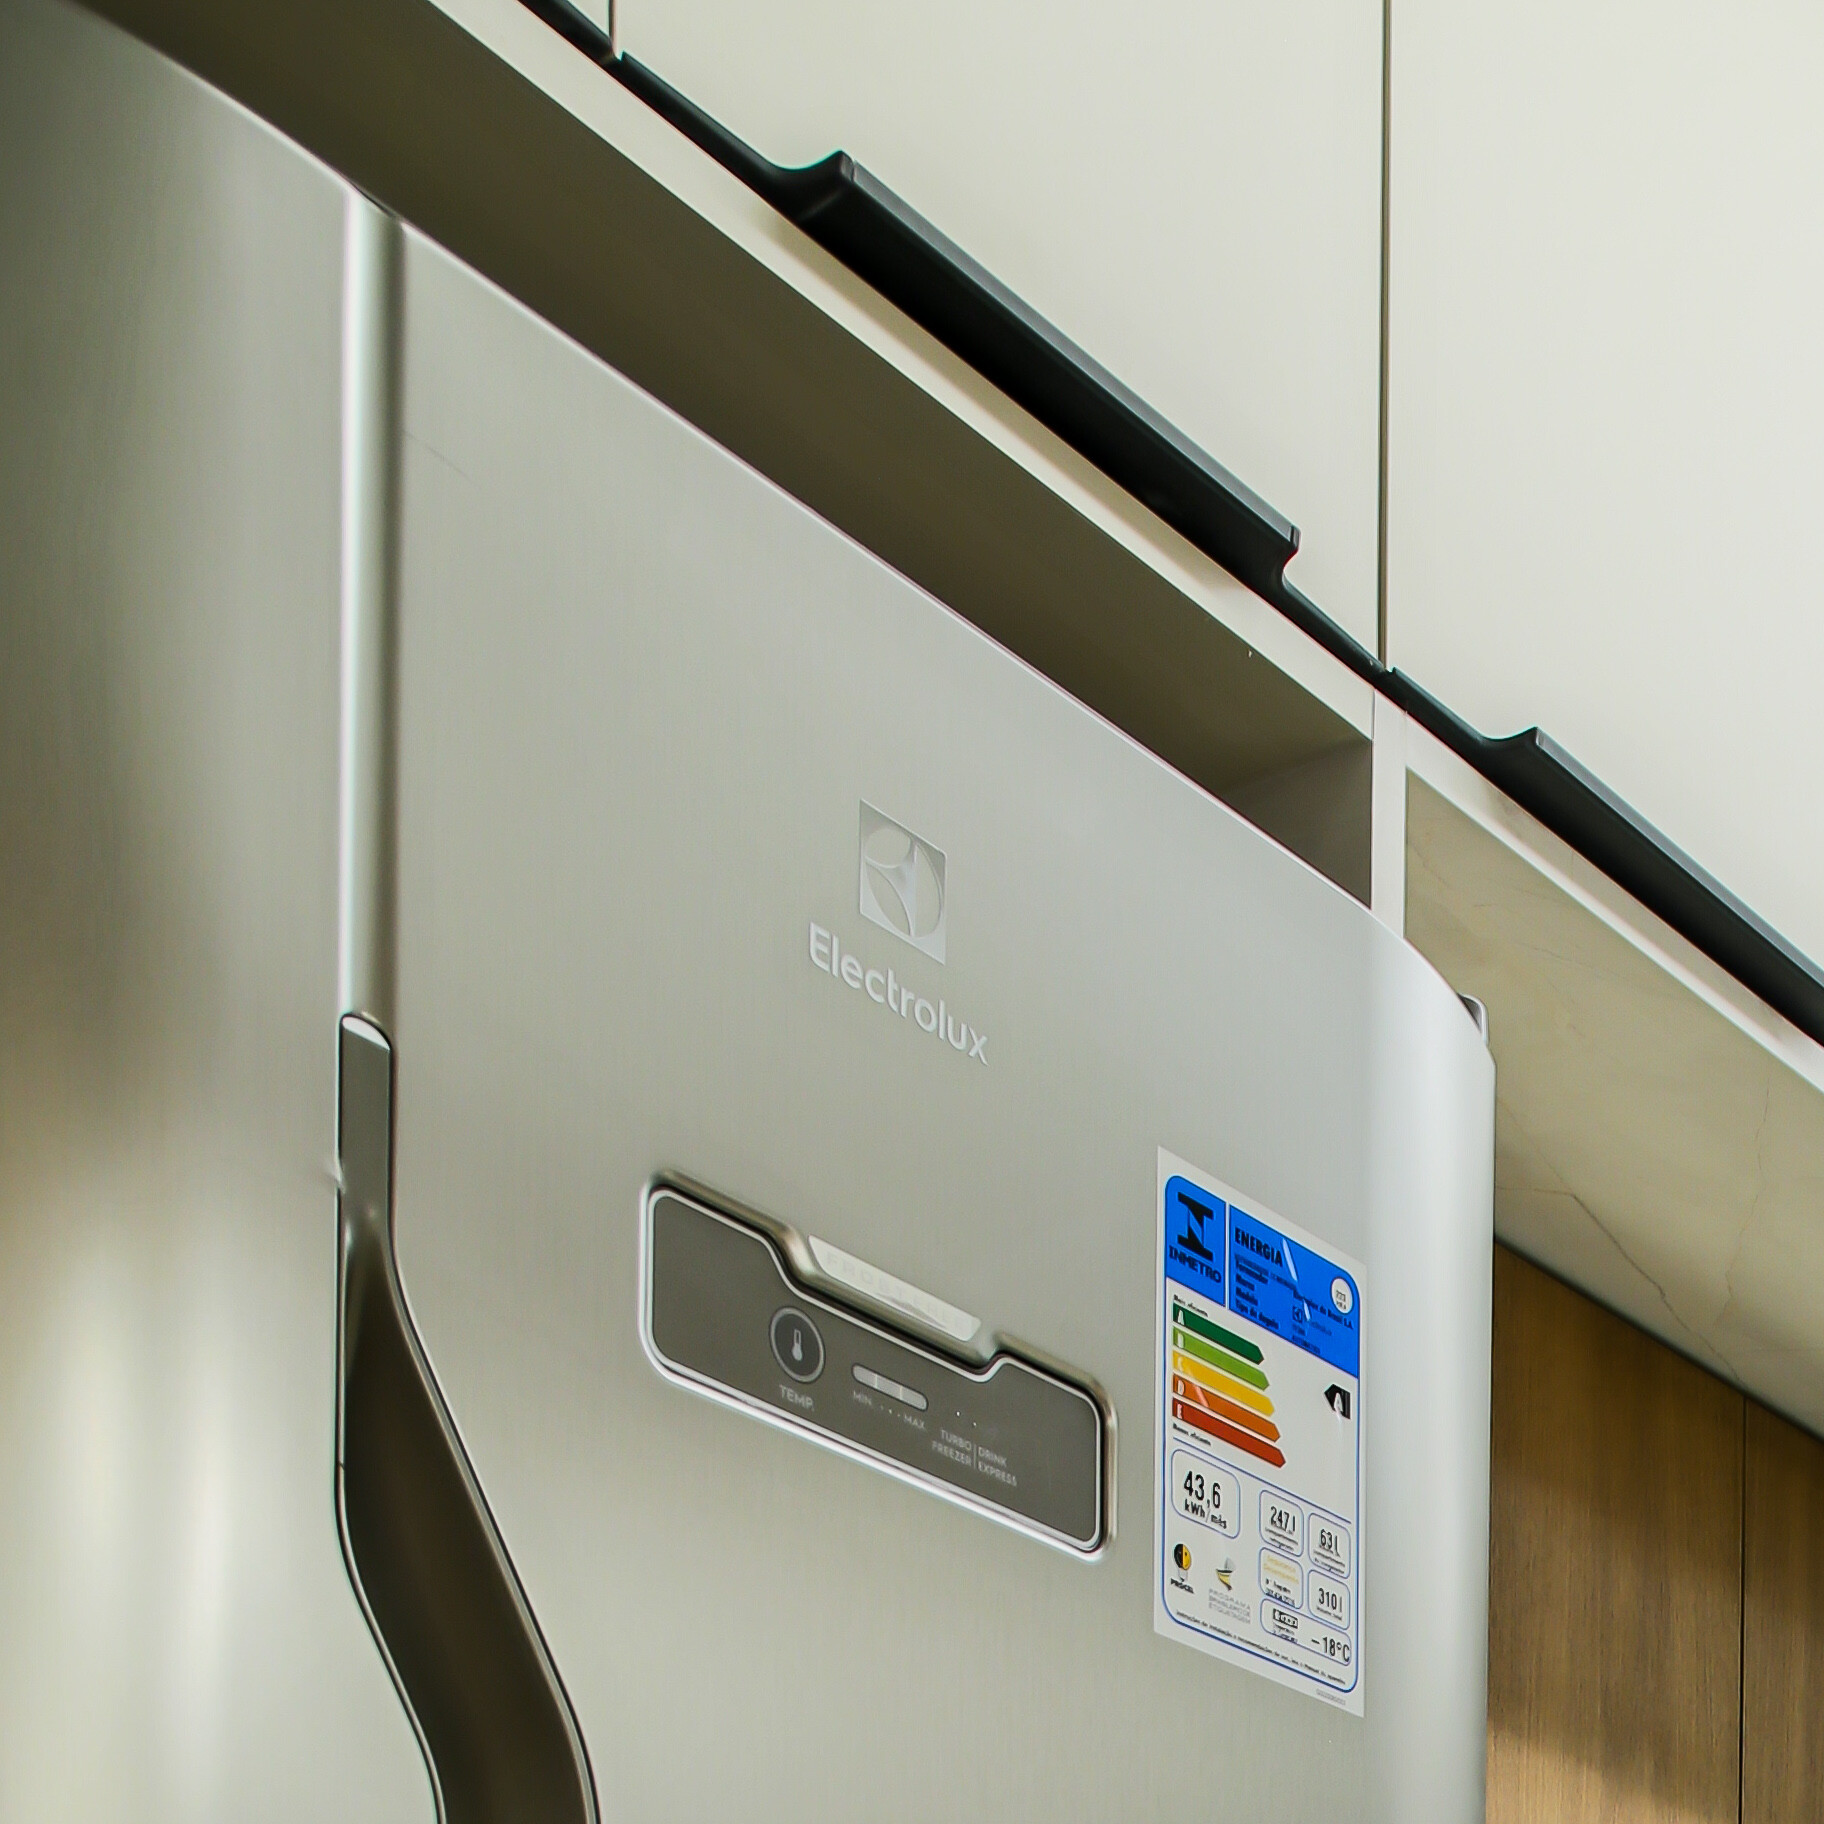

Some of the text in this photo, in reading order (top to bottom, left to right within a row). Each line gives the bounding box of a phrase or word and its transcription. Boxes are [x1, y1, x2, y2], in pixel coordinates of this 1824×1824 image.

[809, 921, 989, 1067] Electrolux
[1234, 1227, 1284, 1267] ENERGIA
[1169, 1245, 1222, 1284] INMETRO
[1177, 1308, 1185, 1326] A
[1177, 1379, 1185, 1396] D
[941, 1429, 972, 1451] TURBO
[932, 1440, 972, 1467] FREEZER
[978, 1446, 1008, 1468] DRINK
[977, 1462, 1018, 1487] EXPRESS
[1183, 1470, 1222, 1510] 43,6
[1318, 1587, 1337, 1612] 310
